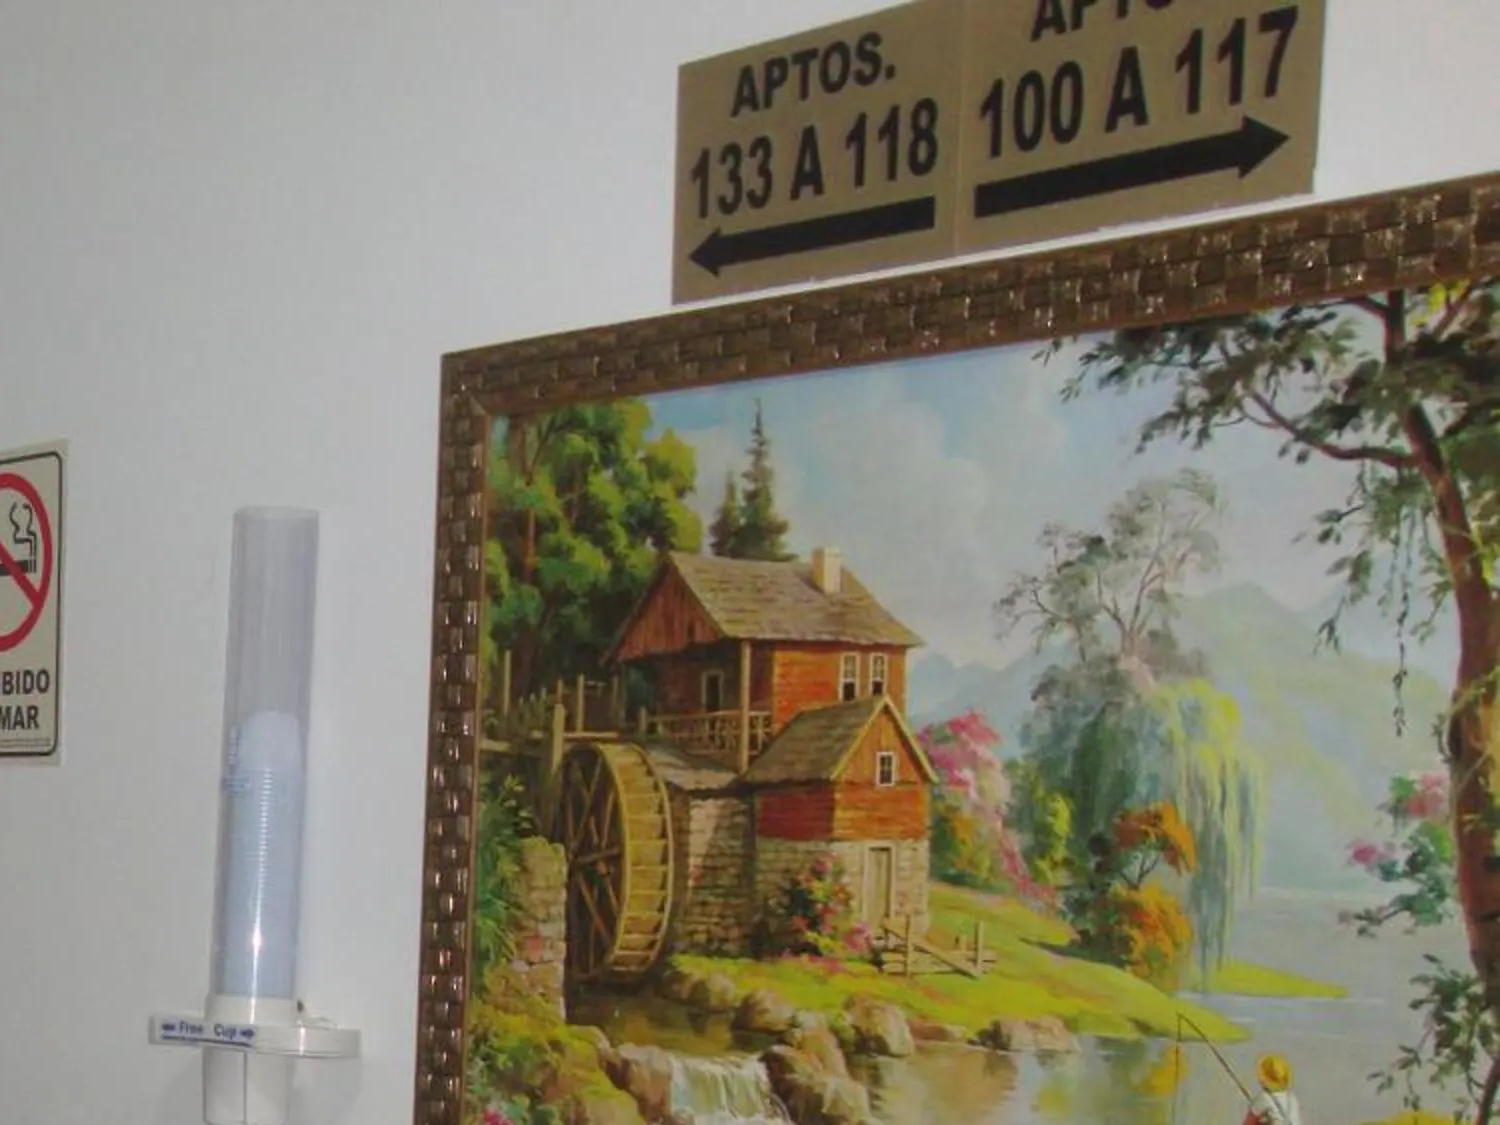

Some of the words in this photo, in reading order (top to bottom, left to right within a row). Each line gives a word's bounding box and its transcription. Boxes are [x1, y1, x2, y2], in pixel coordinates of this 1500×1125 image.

[729, 30, 897, 119] APTOS.
[979, 60, 1085, 160] 100
[1103, 45, 1150, 134] A
[1174, 4, 1299, 115] 117
[691, 134, 773, 220] 133
[789, 124, 826, 202] A
[845, 96, 940, 189] 118
